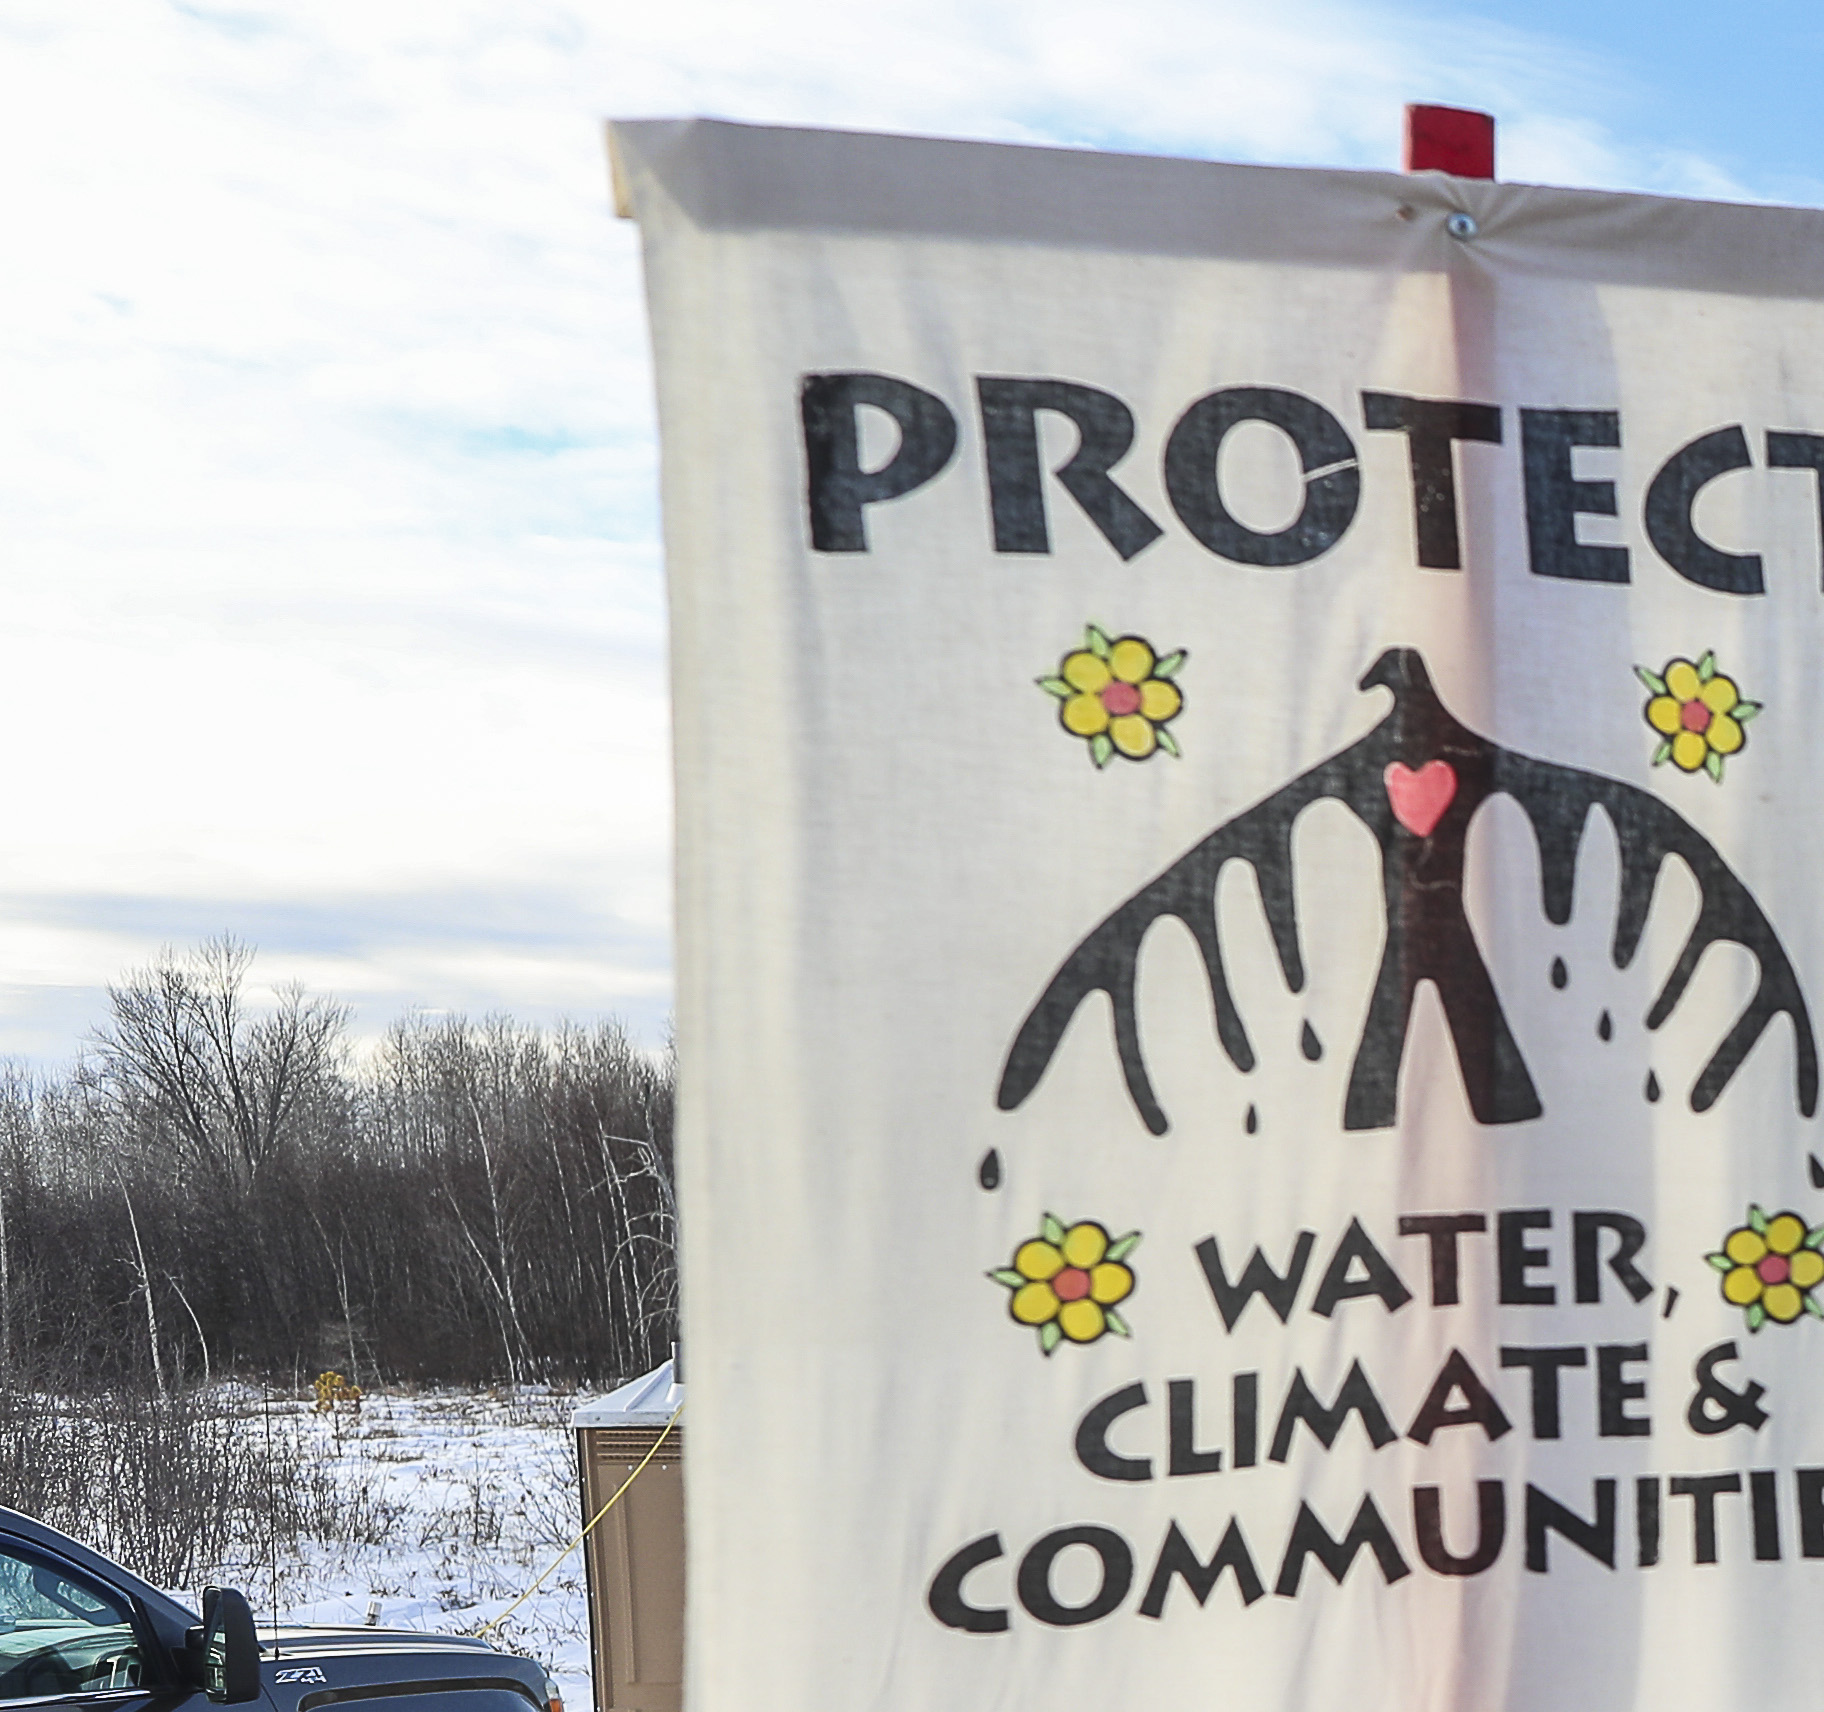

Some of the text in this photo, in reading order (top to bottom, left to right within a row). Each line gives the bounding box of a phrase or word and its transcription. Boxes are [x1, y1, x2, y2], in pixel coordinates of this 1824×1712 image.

[1192, 1207, 1680, 1334] WATER,
[1073, 1338, 1771, 1481] CLIMATE &
